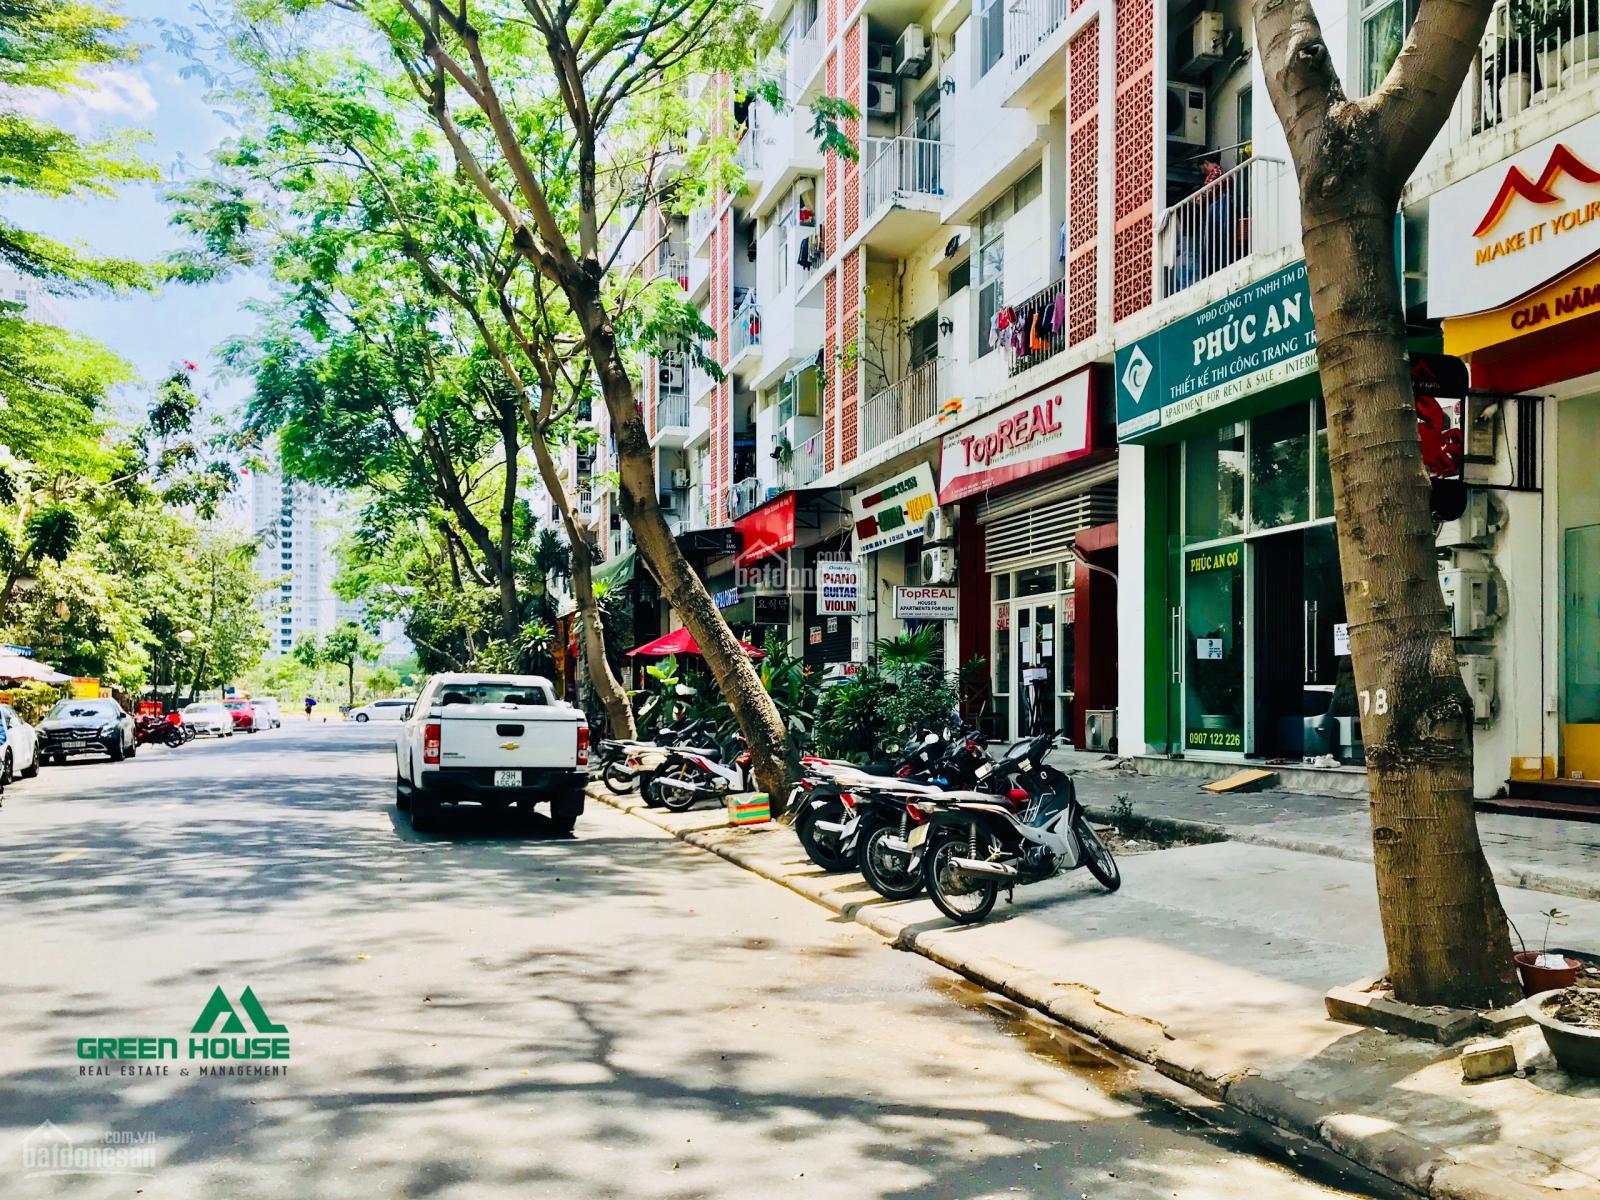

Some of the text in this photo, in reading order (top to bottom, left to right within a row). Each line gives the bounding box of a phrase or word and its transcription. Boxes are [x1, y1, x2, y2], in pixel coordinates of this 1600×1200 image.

[1475, 231, 1525, 266] MAKE
[1529, 221, 1547, 245] IT
[1218, 298, 1242, 316] CÔNG
[1243, 290, 1254, 306] TY
[1255, 280, 1280, 299] TNHH
[1281, 271, 1295, 286] TM
[1192, 292, 1302, 366] PHÚC AN
[1170, 373, 1196, 399] THIẾT
[1212, 364, 1228, 382] THI
[1230, 352, 1259, 375] CÔNG
[1262, 337, 1298, 365] TRANG
[1165, 395, 1204, 419] APARTMENT
[1207, 388, 1221, 403] FOR
[1223, 380, 1243, 397] RENT
[1256, 370, 1274, 386] SALE
[961, 399, 1062, 467] TopREAL
[1190, 553, 1211, 572] PHÚC
[1213, 553, 1225, 568] AN
[823, 573, 857, 584] PIANO
[823, 587, 857, 598] GUITAR
[899, 588, 955, 600] TopREAL
[825, 600, 856, 611] VIOLIN
[1190, 732, 1240, 746] 0907 122 226
[500, 771, 516, 780] 29H
